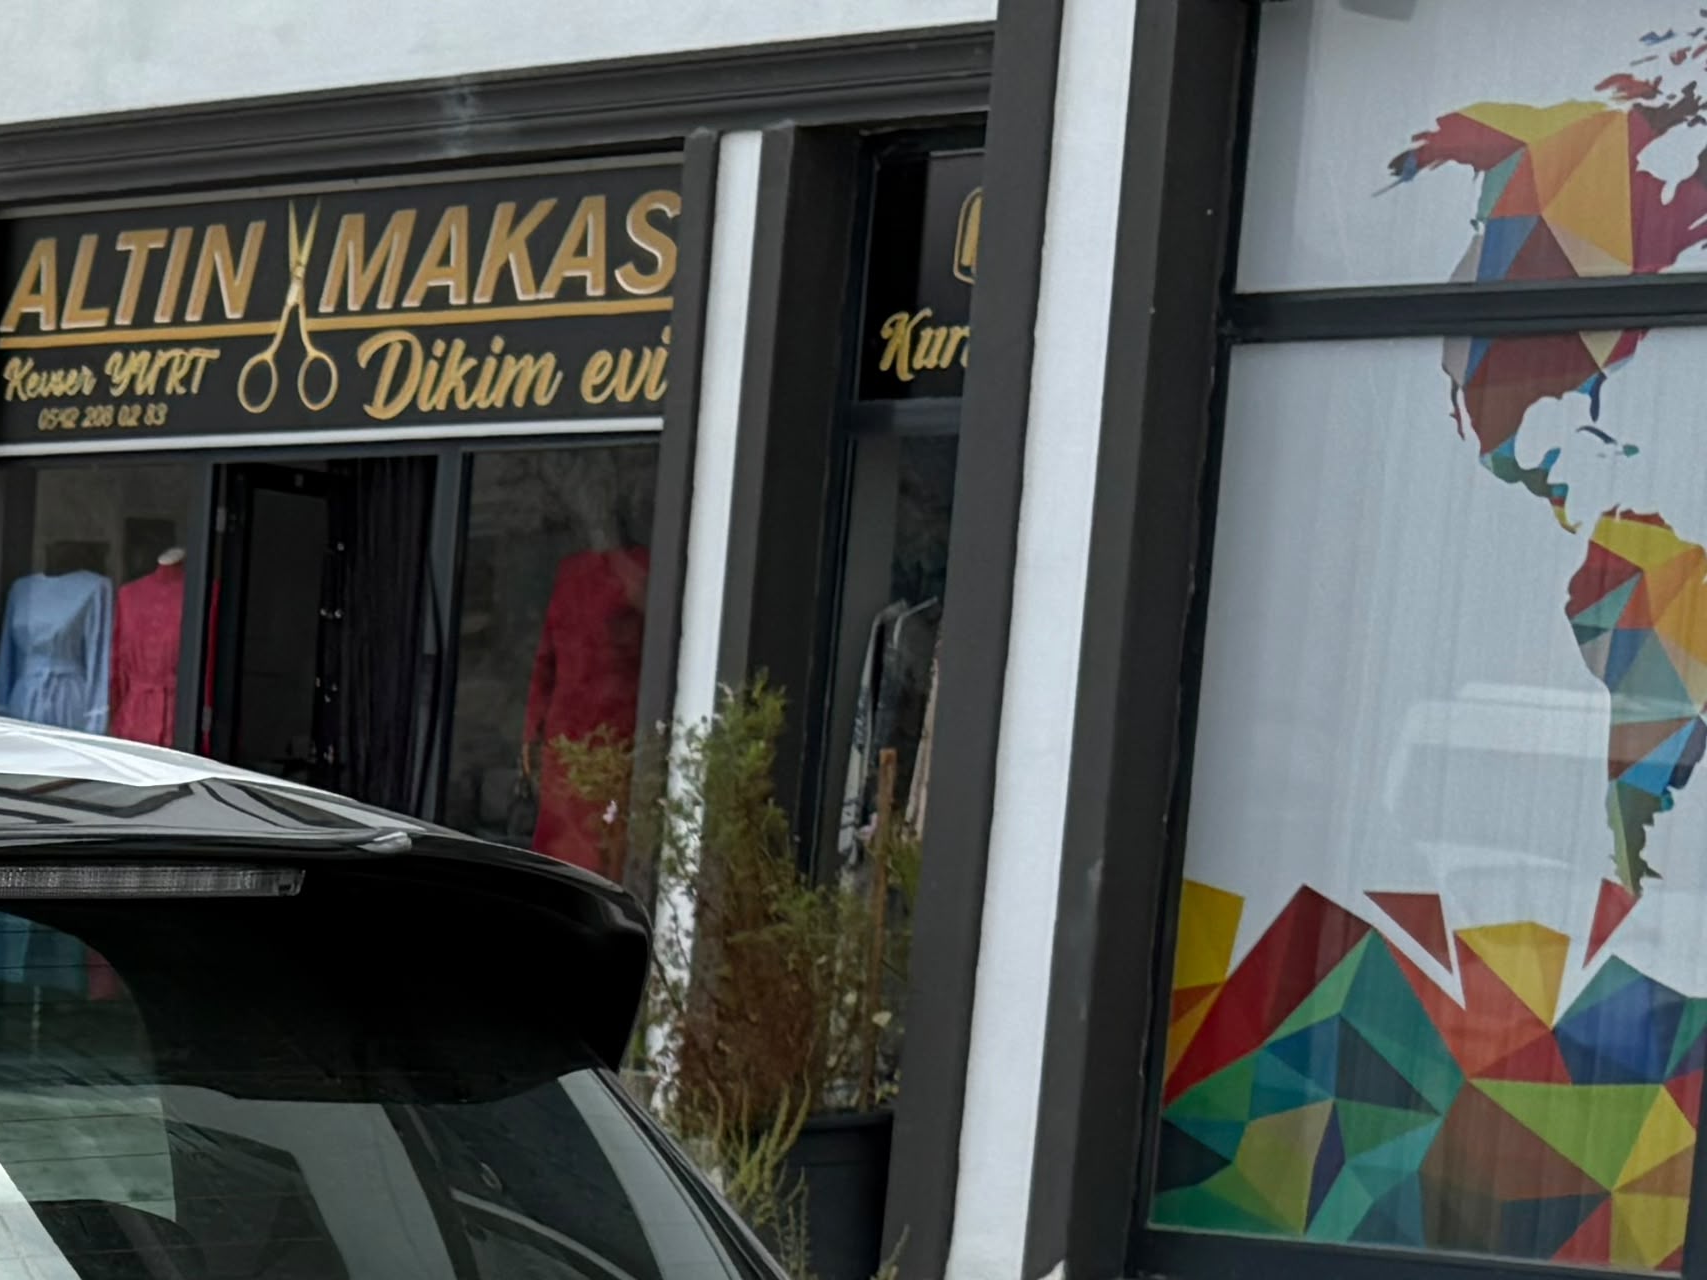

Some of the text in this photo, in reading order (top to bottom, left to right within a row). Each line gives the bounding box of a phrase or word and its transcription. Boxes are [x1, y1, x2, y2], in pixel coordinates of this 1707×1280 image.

[0, 190, 682, 332] ALTIN MAKAS
[105, 347, 220, 397] YURT
[357, 325, 672, 420] Dikim evi
[879, 306, 971, 382] Kur
